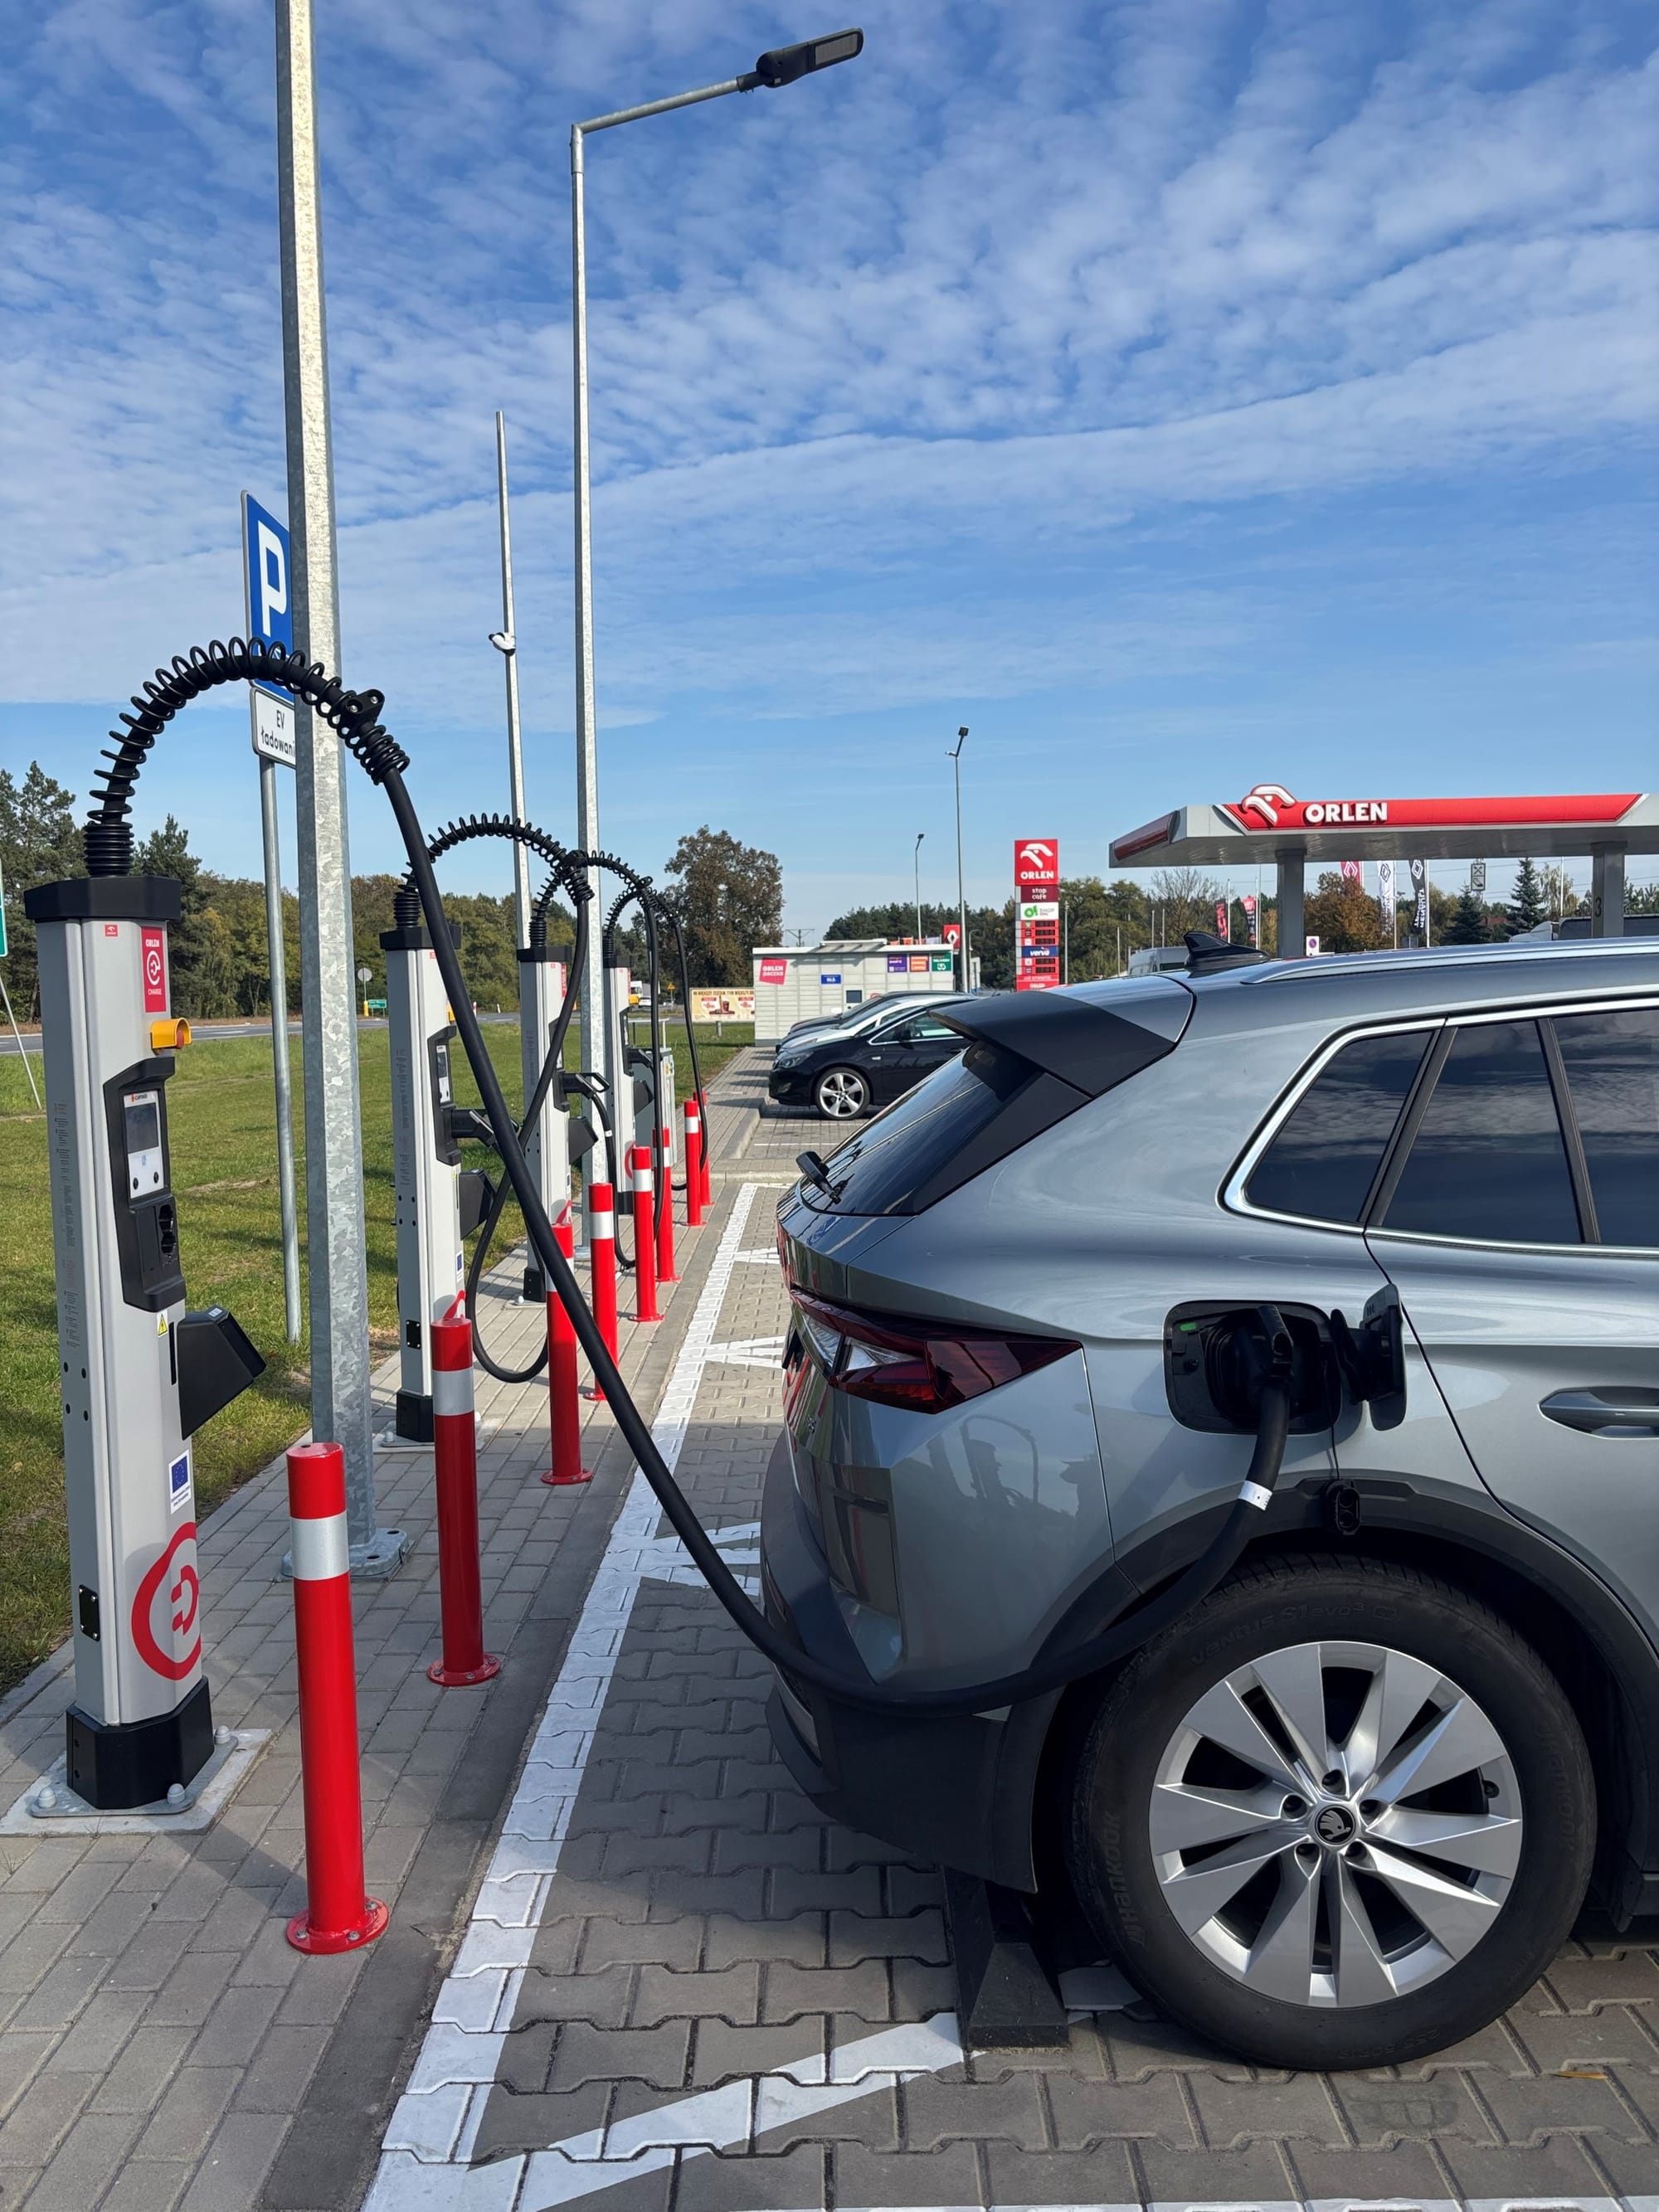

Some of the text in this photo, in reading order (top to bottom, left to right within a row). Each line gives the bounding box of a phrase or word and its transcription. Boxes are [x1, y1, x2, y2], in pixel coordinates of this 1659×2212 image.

[258, 519, 287, 638] P
[276, 709, 285, 730] EV
[260, 725, 295, 757] ładowani
[1305, 802, 1388, 824] ORLEN
[1020, 871, 1054, 880] ORLEN
[1594, 897, 1602, 917] 3
[145, 938, 160, 948] ORLEN
